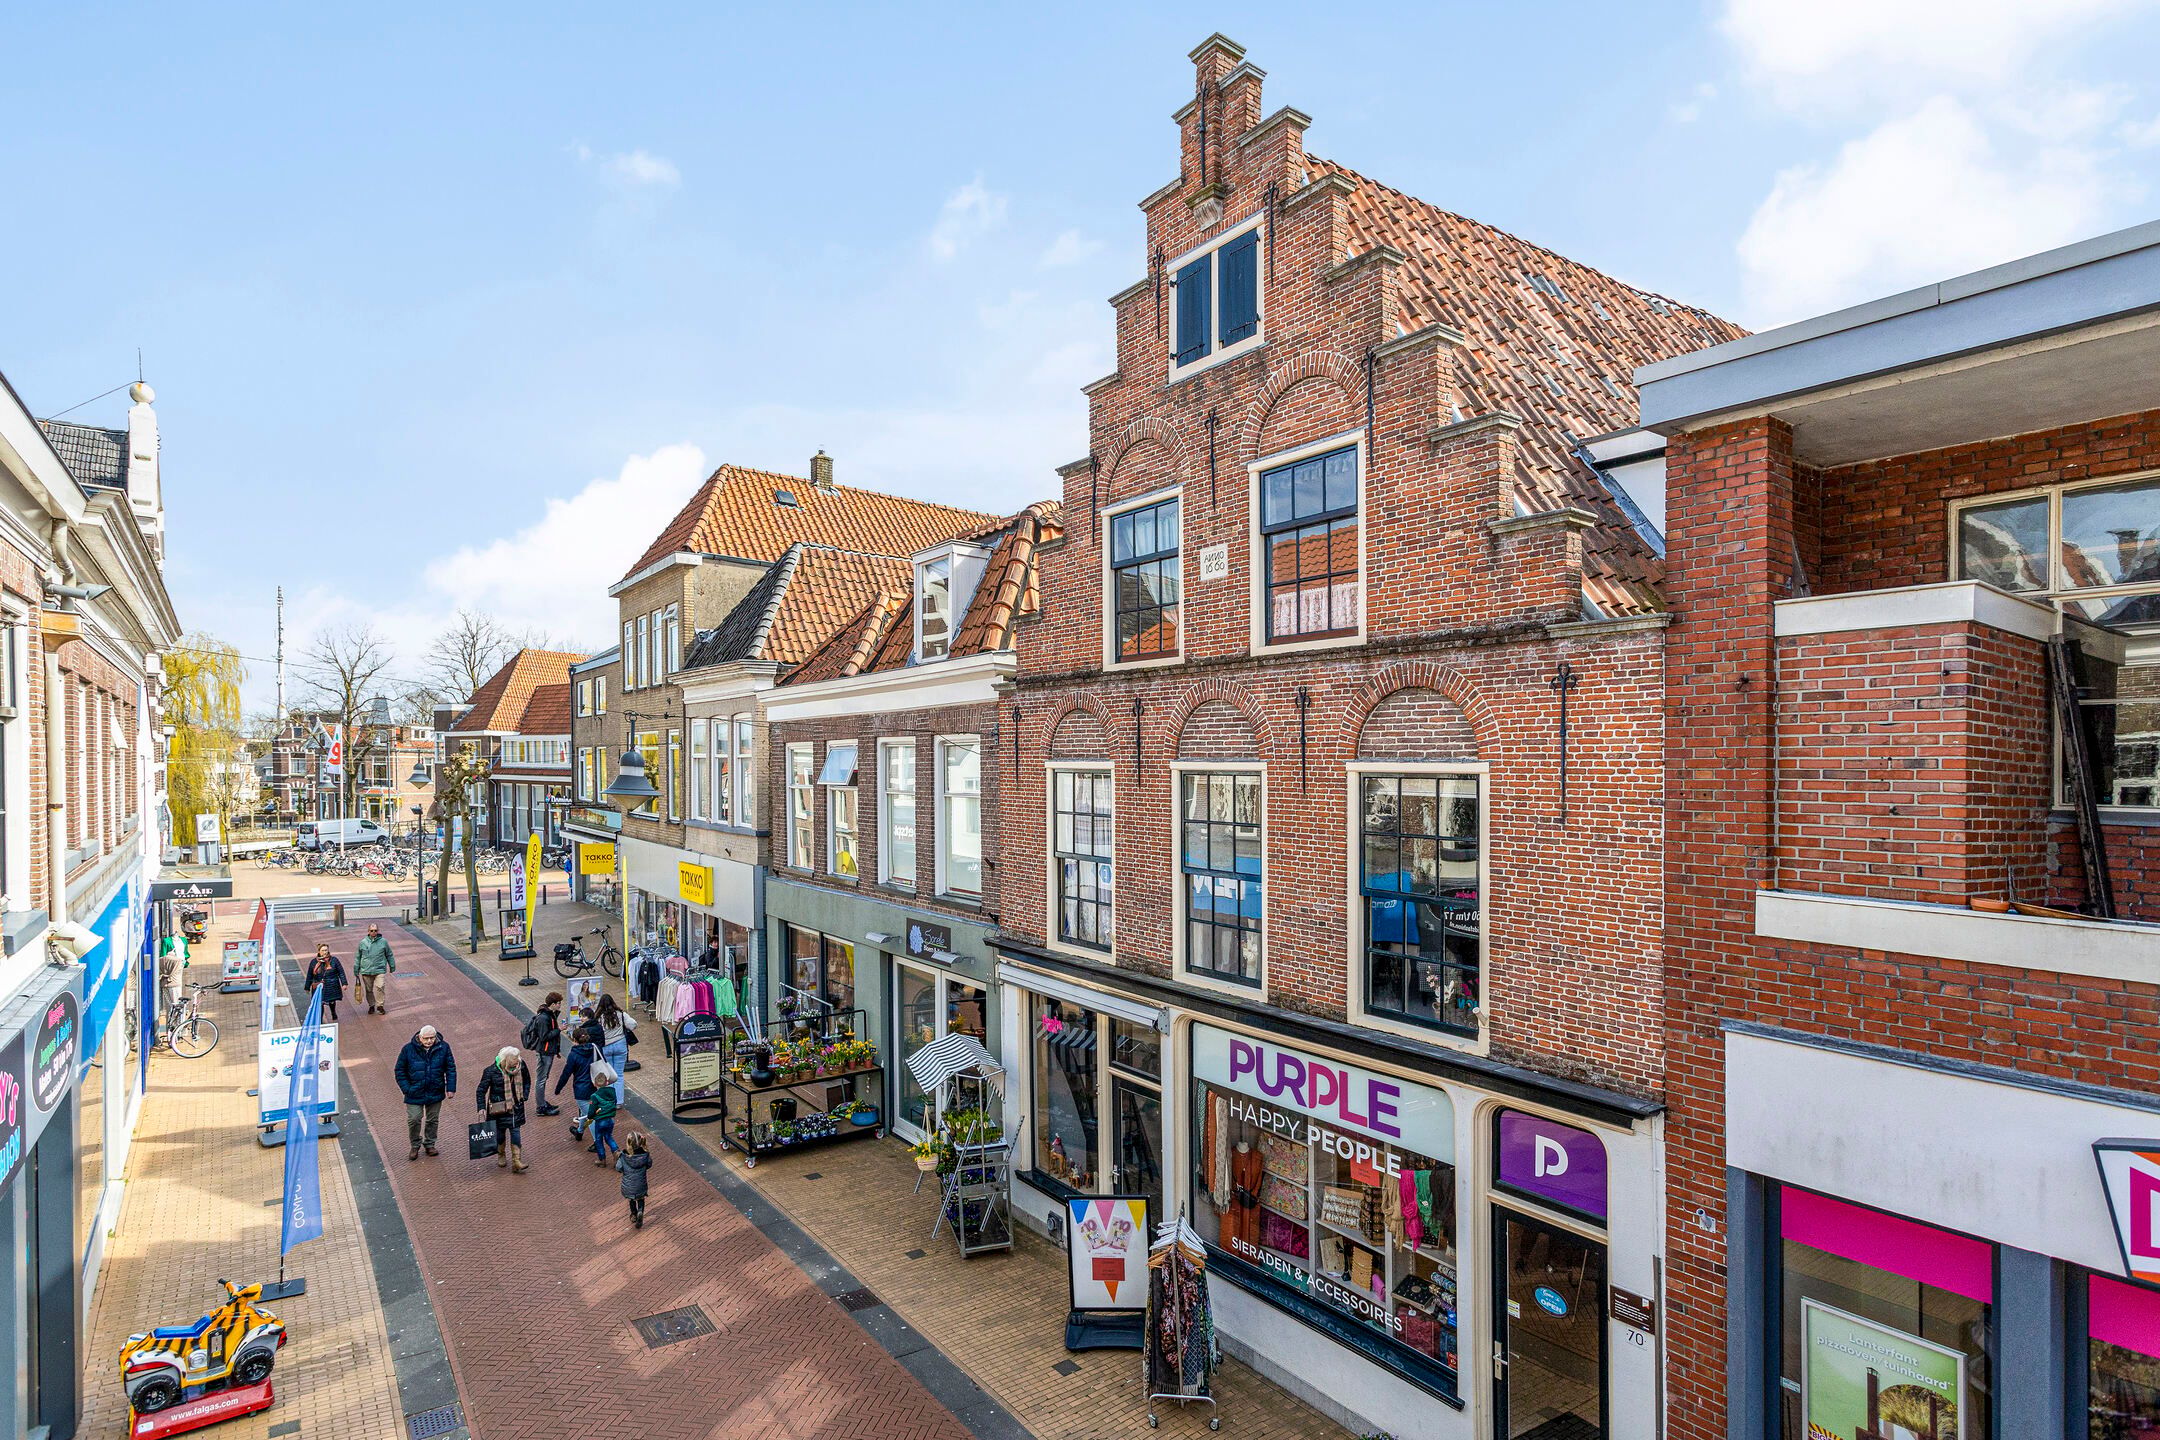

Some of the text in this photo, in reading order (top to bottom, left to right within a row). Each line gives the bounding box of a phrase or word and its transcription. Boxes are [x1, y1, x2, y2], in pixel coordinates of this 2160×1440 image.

[585, 853, 613, 861] TAKKO
[514, 877, 524, 902] SNS
[1229, 1097, 1403, 1180] HAPPY PEOPLE
[1231, 1235, 1403, 1333] SIERADEN & ACCESSOIRES
[1540, 1298, 1562, 1314] OPEN
[1627, 1329, 1644, 1346] 70
[1848, 1332, 1920, 1367] Lanterfant
[170, 1396, 240, 1422] www.falgas.com
